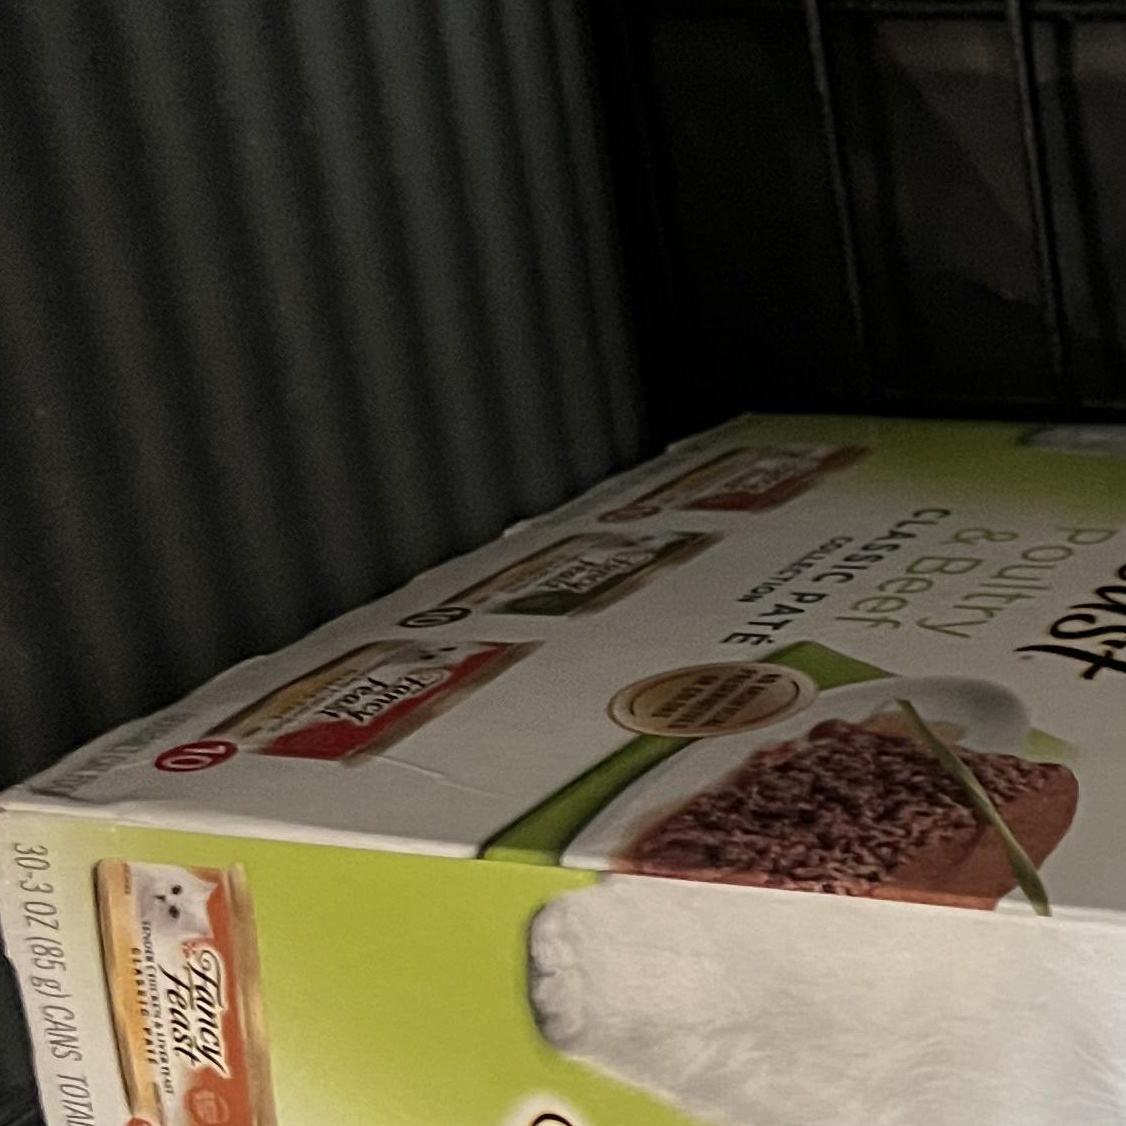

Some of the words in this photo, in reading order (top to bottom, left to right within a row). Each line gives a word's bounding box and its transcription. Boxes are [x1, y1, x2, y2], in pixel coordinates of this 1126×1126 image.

[813, 508, 950, 584] CLASSIC
[944, 526, 1018, 546] &
[737, 536, 853, 603] COLLECTION
[837, 555, 986, 629] Beef
[917, 526, 1117, 638] Poultry
[721, 592, 829, 647] PATÉ
[161, 744, 226, 769] 10
[13, 842, 48, 893] 30-3
[25, 901, 59, 930] OZ
[26, 937, 62, 971] (85
[31, 976, 67, 999] g)
[187, 950, 229, 1076] Fancy
[43, 1005, 82, 1062] CANS
[159, 965, 198, 1068] Feast
